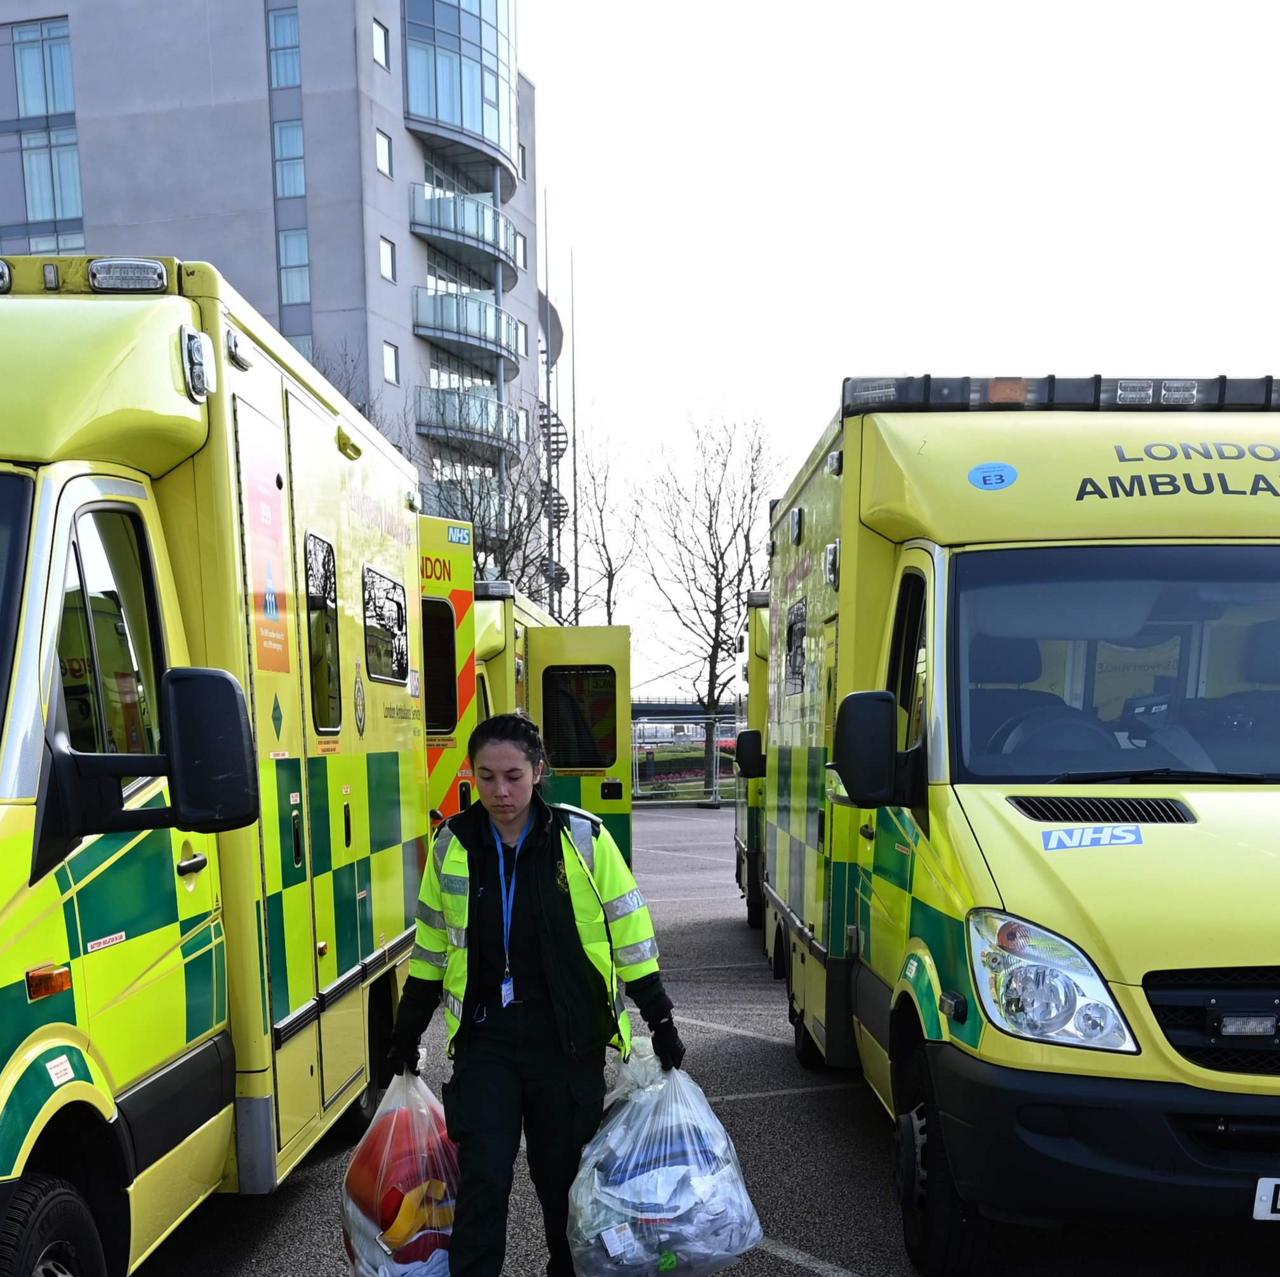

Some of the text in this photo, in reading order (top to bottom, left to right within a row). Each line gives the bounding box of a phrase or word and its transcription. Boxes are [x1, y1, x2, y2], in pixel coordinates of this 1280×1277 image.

[982, 474, 1005, 485] E3
[449, 527, 470, 544] NHS
[1047, 825, 1138, 849] NHS
